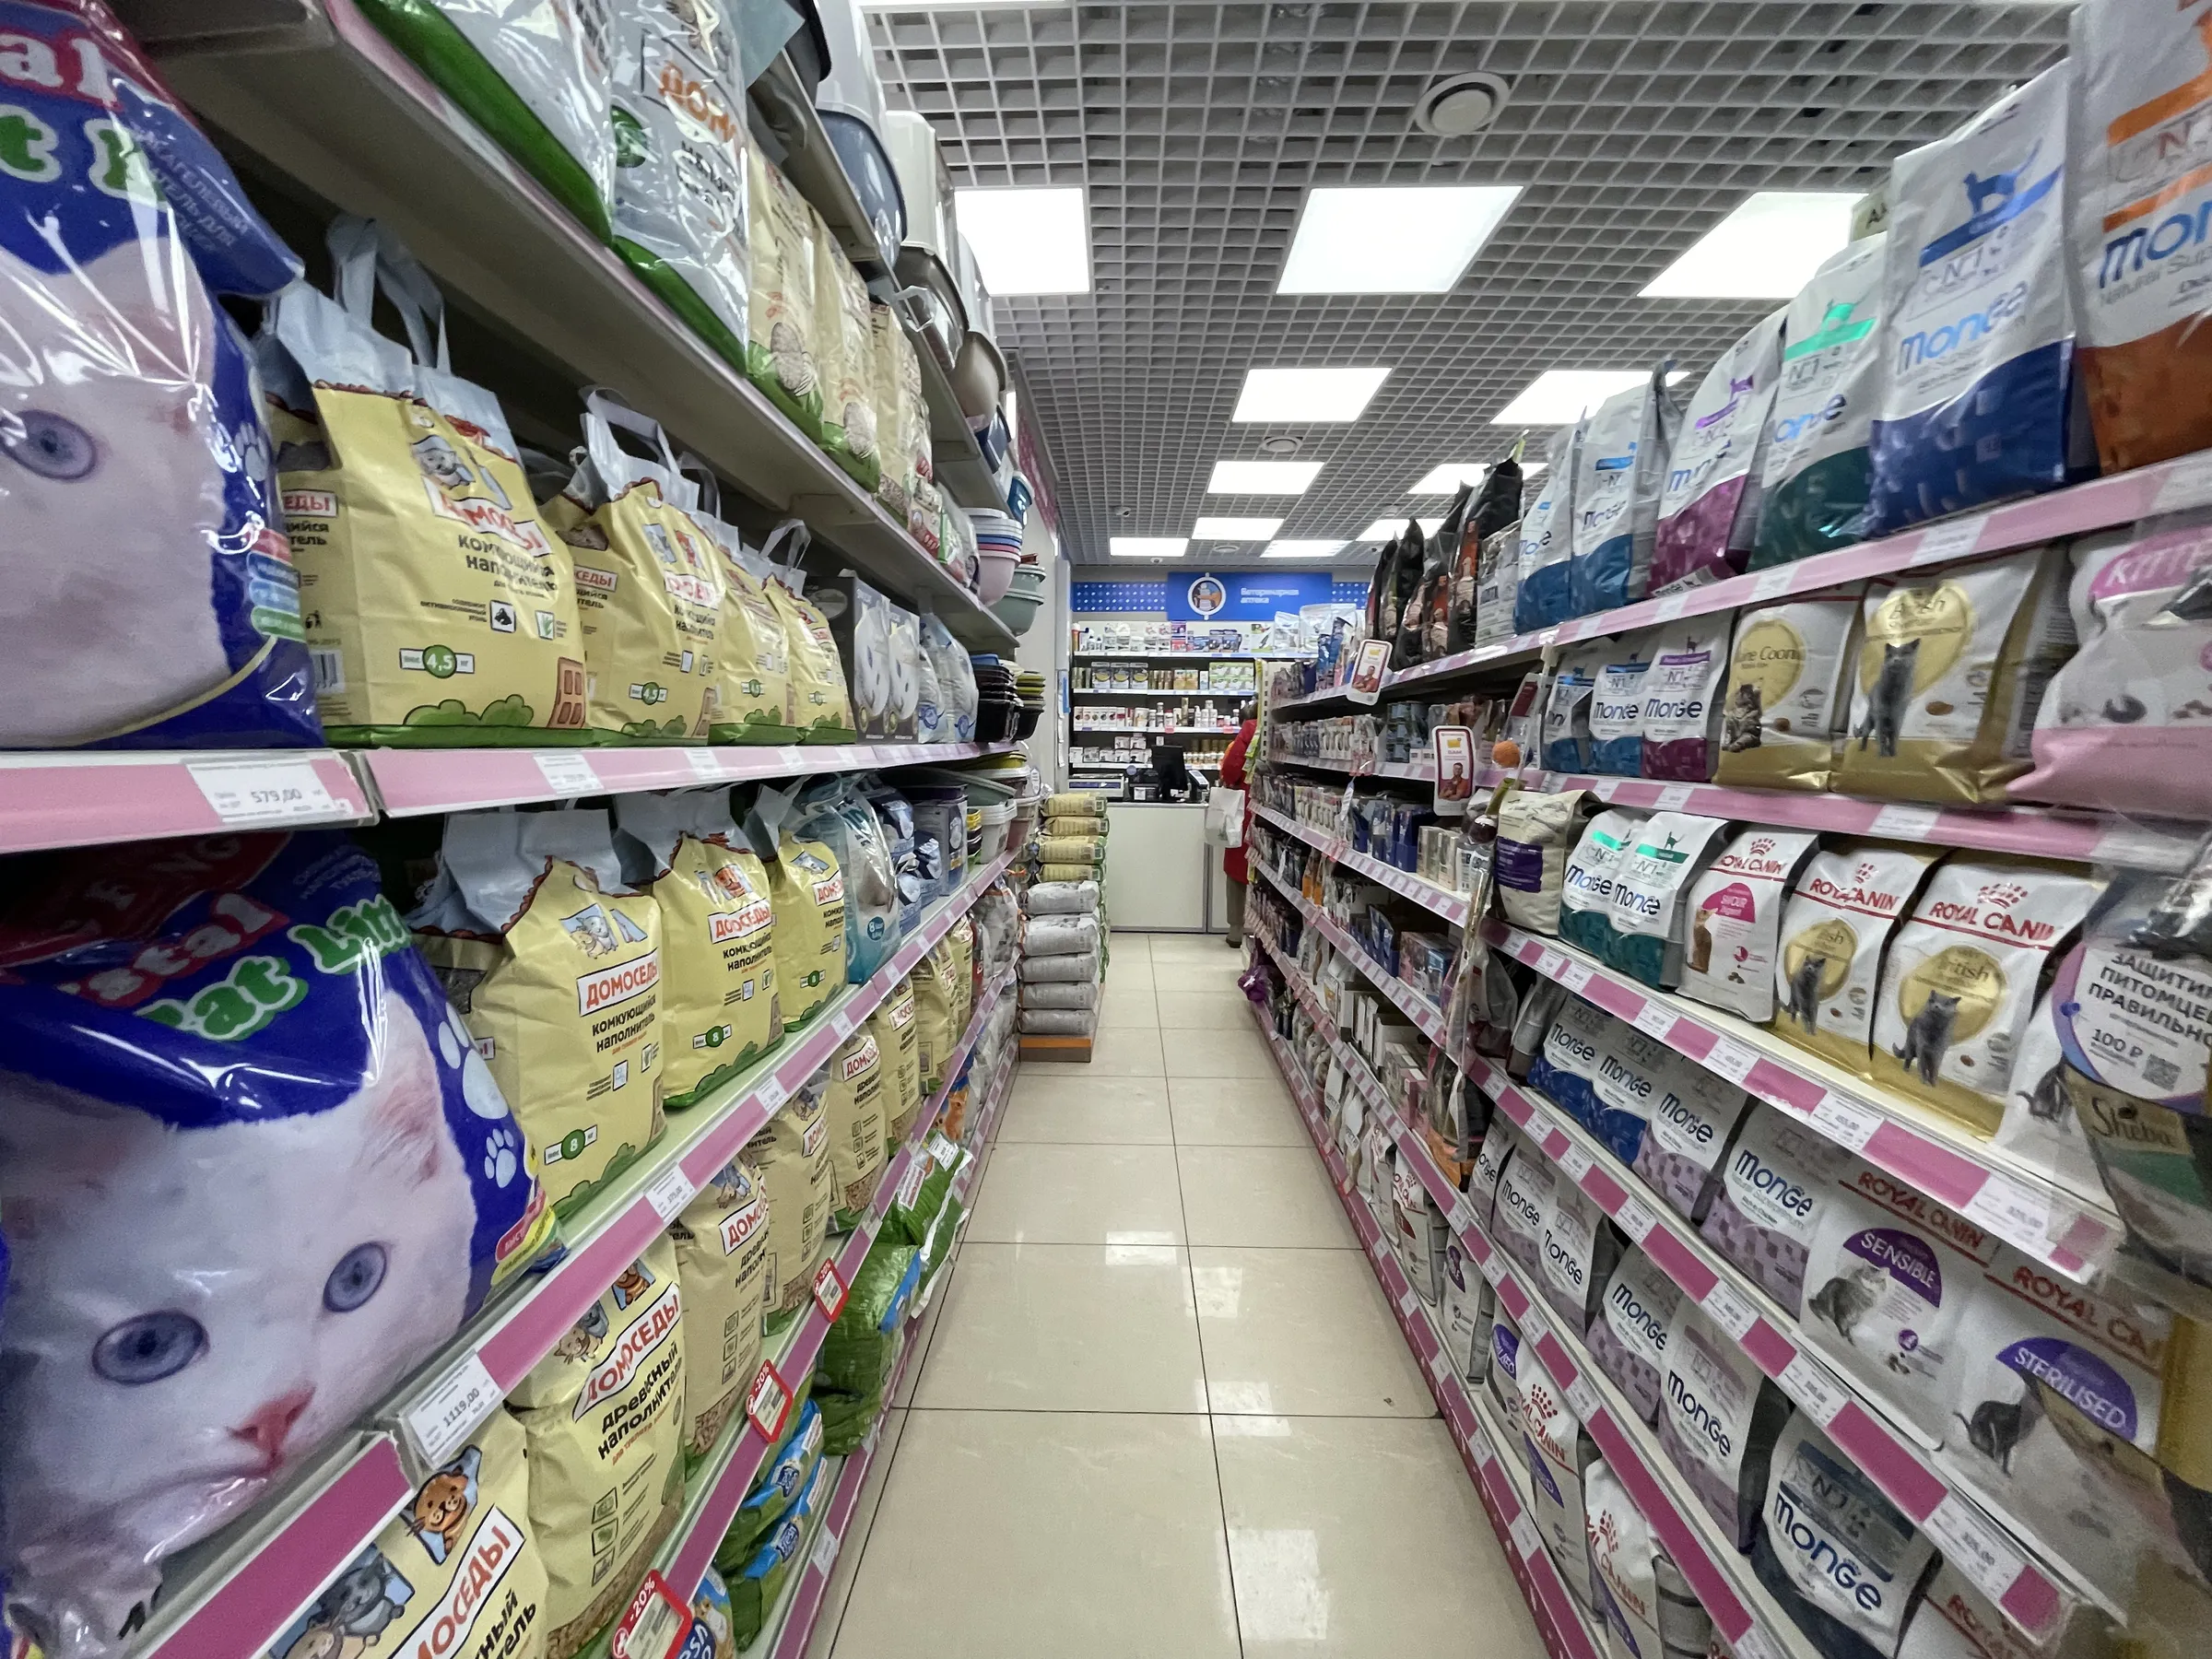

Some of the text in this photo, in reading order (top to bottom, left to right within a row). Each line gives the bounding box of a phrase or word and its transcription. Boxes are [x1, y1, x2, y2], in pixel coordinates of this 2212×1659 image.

[426, 653, 454, 673] 4,5
[1928, 900, 1978, 925] ROYAL
[2091, 1028, 2126, 1052] 100
[1599, 1054, 1653, 1098] monge
[1659, 1091, 1714, 1144] monge
[569, 1137, 580, 1152] 8
[1477, 1152, 1497, 1182] onge
[1501, 1179, 1541, 1227] monge
[1735, 1148, 1814, 1218] monge
[1858, 1171, 1926, 1219] ROYAL
[1860, 1231, 1937, 1289] SENSIBLE
[1611, 1281, 1668, 1351] monge
[2012, 1265, 2099, 1327] ROYAL
[583, 1292, 679, 1409] ДОМОСЕДЫ
[755, 1362, 770, 1393] -20%
[2014, 1346, 2127, 1429] STERILISED
[441, 1387, 481, 1428] 1119,00
[1667, 1369, 1732, 1457] monge
[1773, 1492, 1883, 1612] monge
[629, 1575, 655, 1622] -20%
